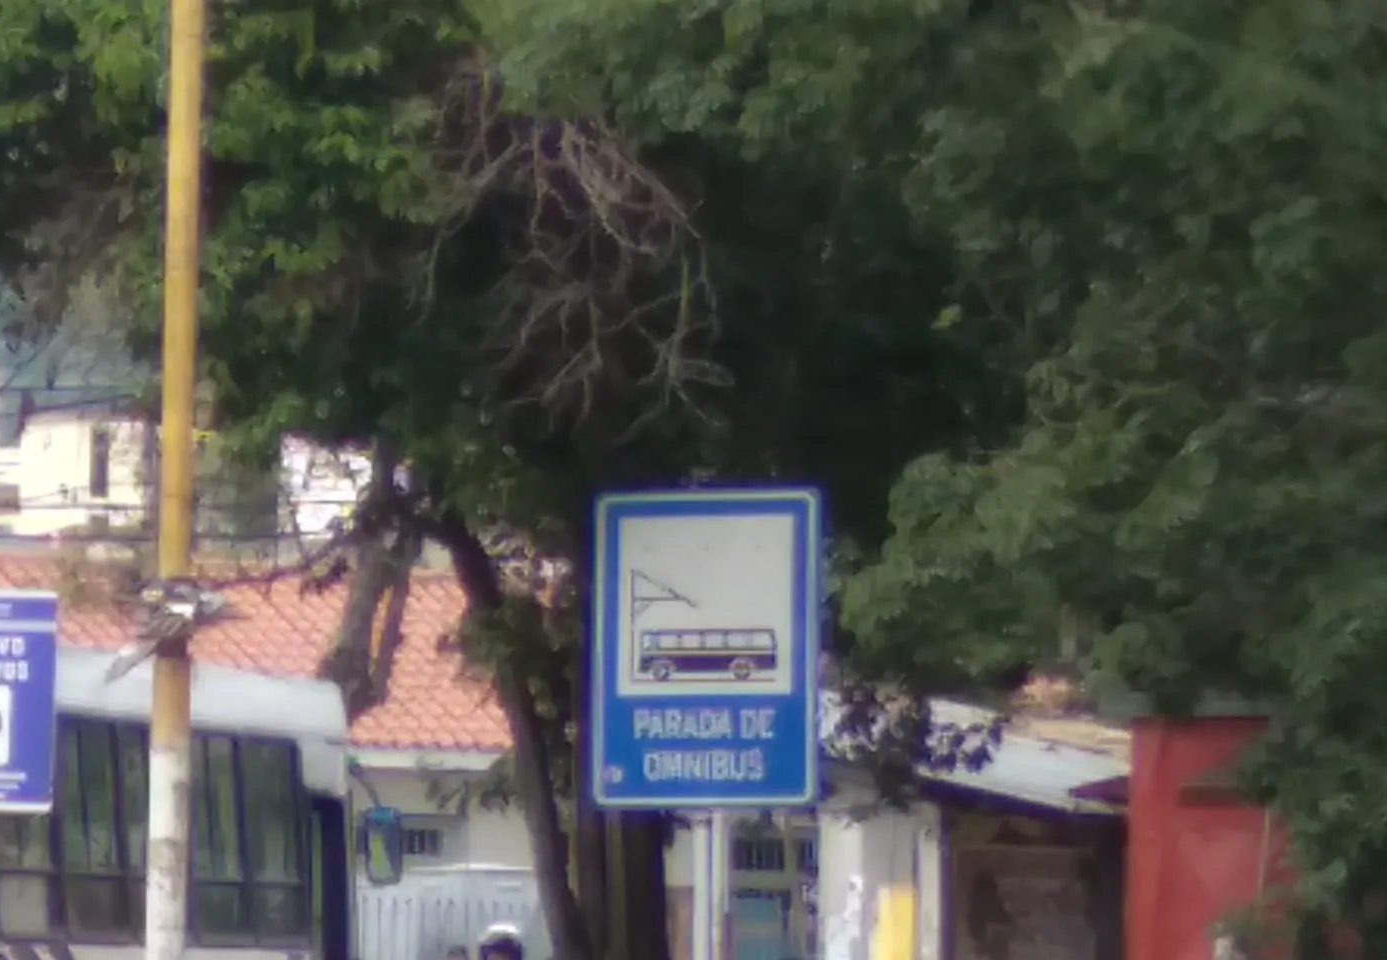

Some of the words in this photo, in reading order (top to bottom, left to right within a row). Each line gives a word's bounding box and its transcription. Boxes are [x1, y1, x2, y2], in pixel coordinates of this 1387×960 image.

[633, 709, 732, 739] PARADA
[740, 708, 776, 739] DE
[643, 749, 764, 782] OMNIBUS
